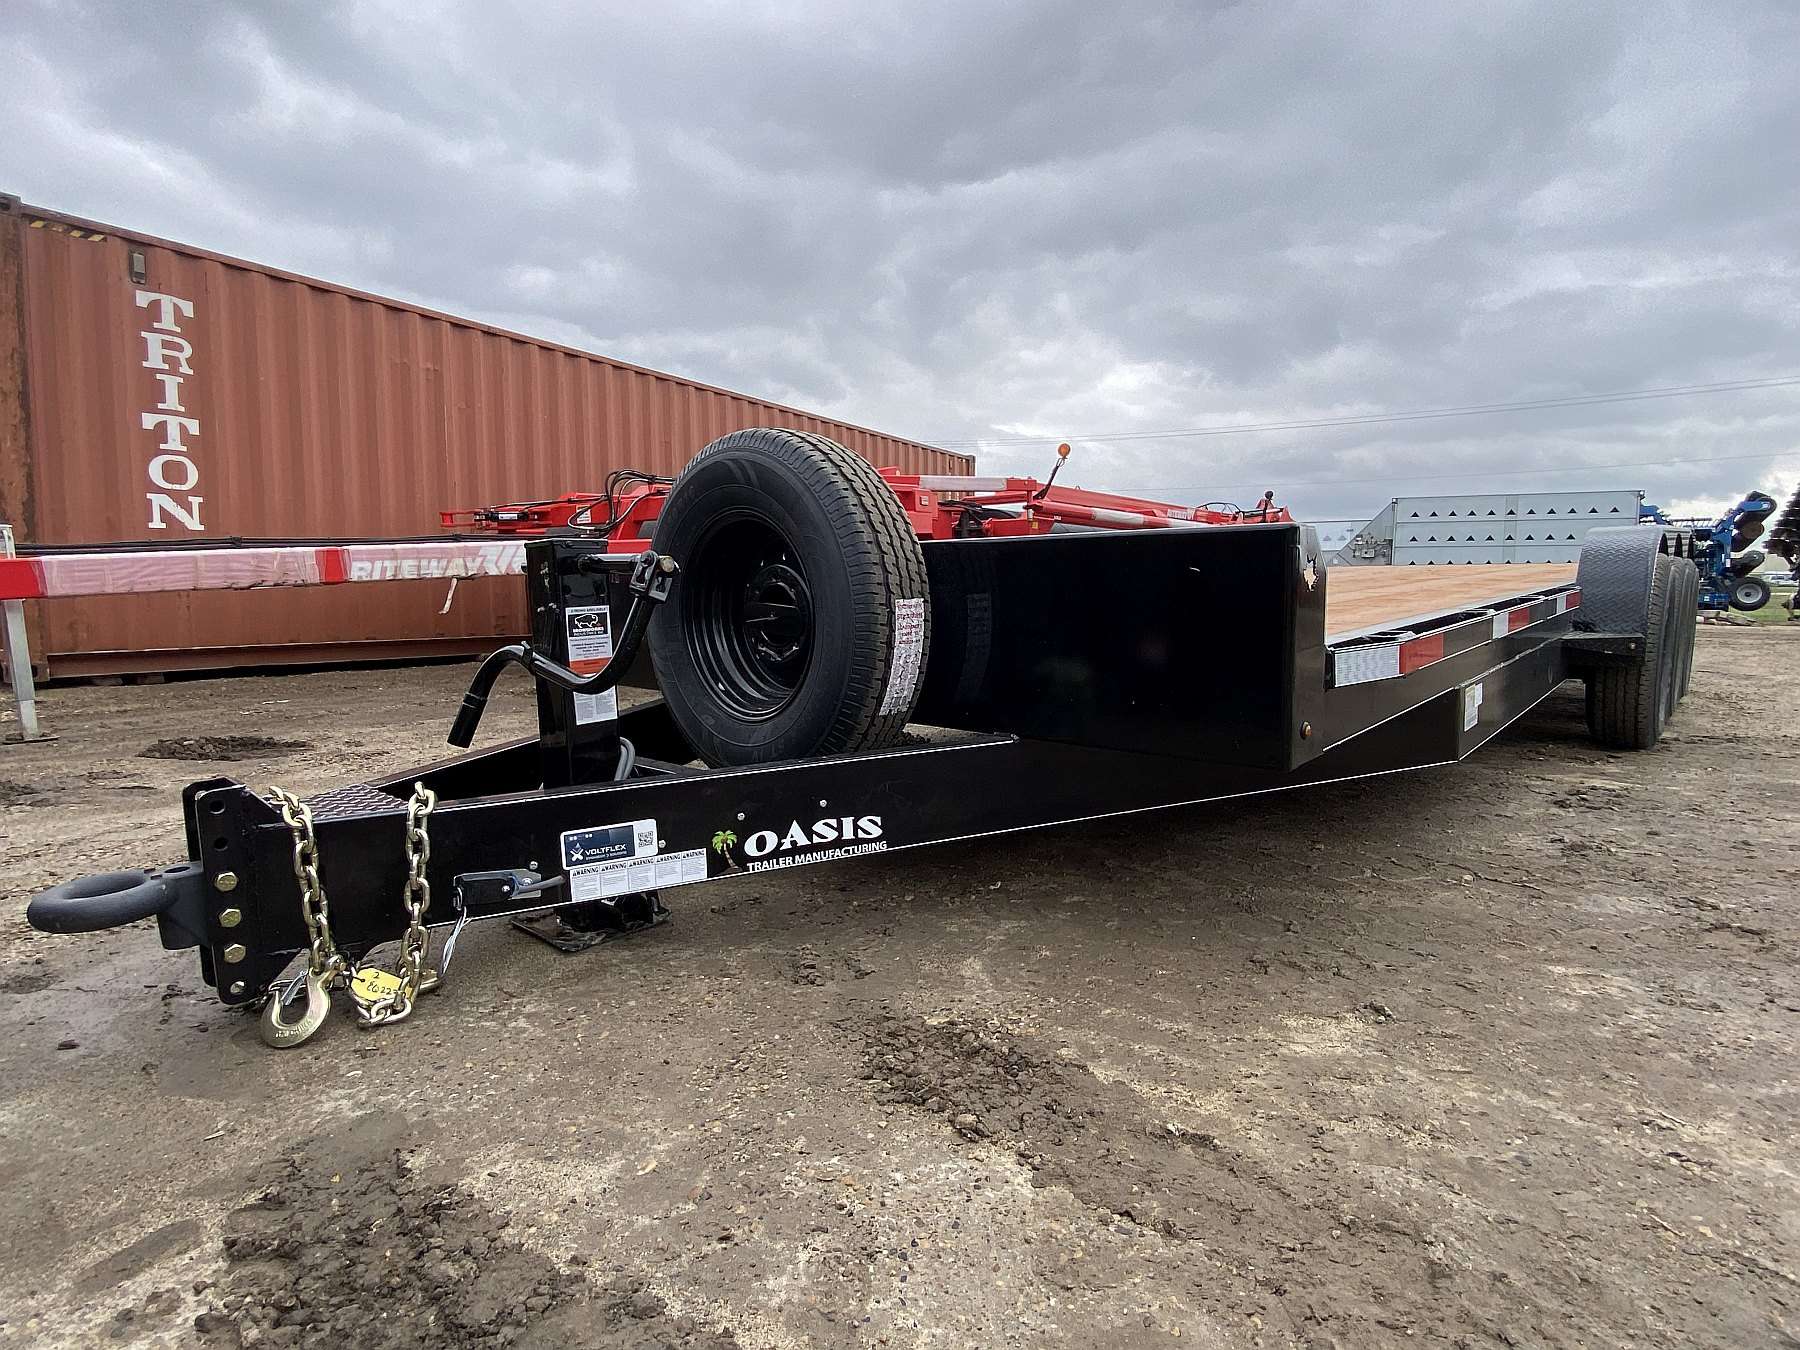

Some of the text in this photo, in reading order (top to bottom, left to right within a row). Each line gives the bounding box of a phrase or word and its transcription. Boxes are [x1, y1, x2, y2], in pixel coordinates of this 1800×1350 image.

[136, 290, 205, 530] TRITON
[352, 557, 482, 580] RITEWAY
[585, 843, 627, 855] VOLTFLEX
[744, 815, 883, 857] OASIS
[576, 850, 705, 876] WARNING WARNING WARNING WARNING WARNING
[747, 841, 887, 872] TRAILER MANUFACTURING
